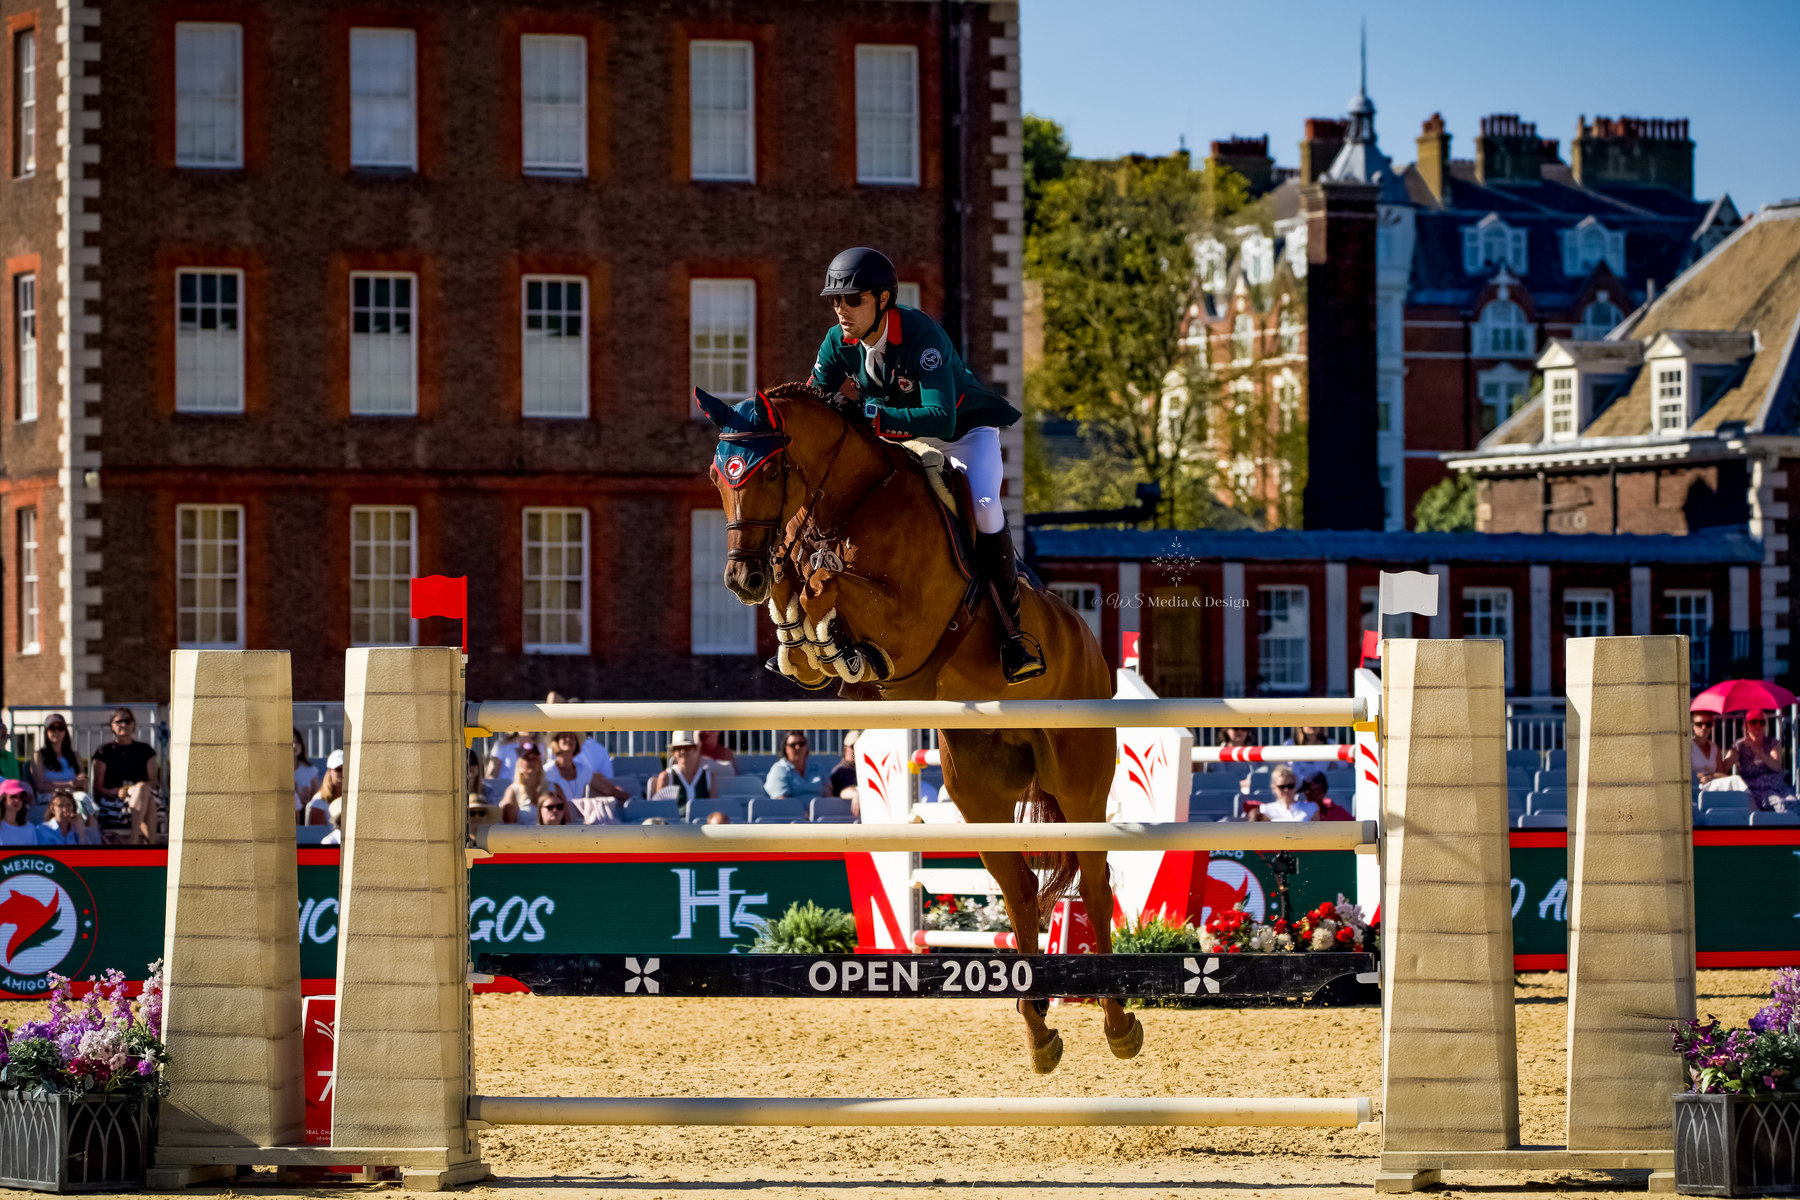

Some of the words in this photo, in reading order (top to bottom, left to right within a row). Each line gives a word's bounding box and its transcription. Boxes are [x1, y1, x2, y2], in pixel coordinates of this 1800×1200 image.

[2, 859, 55, 874] MEXICO
[470, 895, 555, 942] GOS
[808, 960, 919, 992] OPEN
[942, 960, 1033, 992] 2030
